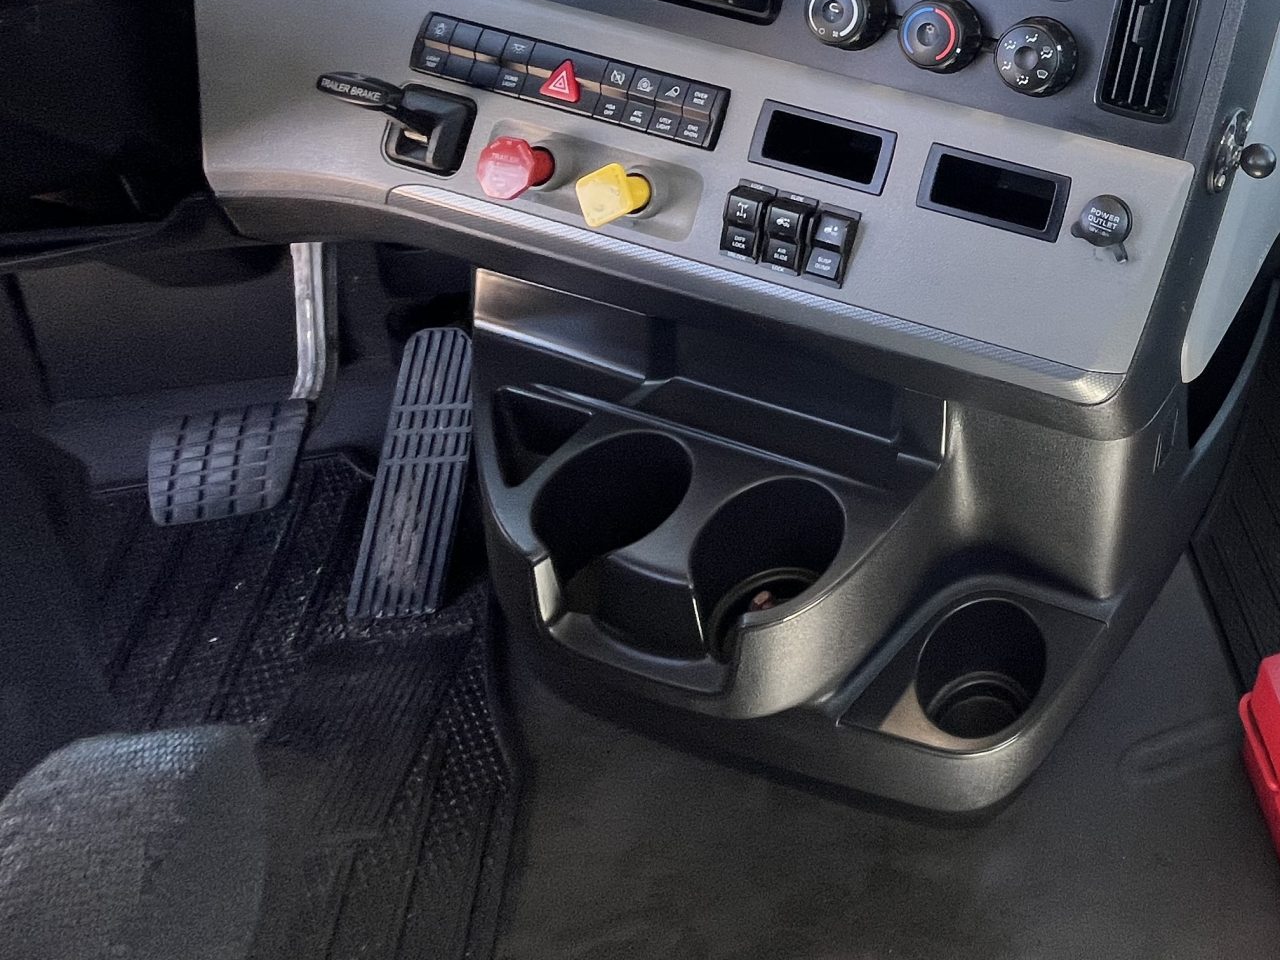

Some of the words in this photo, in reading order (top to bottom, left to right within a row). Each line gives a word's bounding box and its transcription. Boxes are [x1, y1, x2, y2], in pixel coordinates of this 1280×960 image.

[321, 78, 351, 93] TRAILER
[350, 85, 382, 101] BRAKE
[1088, 214, 1118, 230] OUTLET
[1091, 207, 1120, 223] POWER
[732, 241, 745, 249] LOCK
